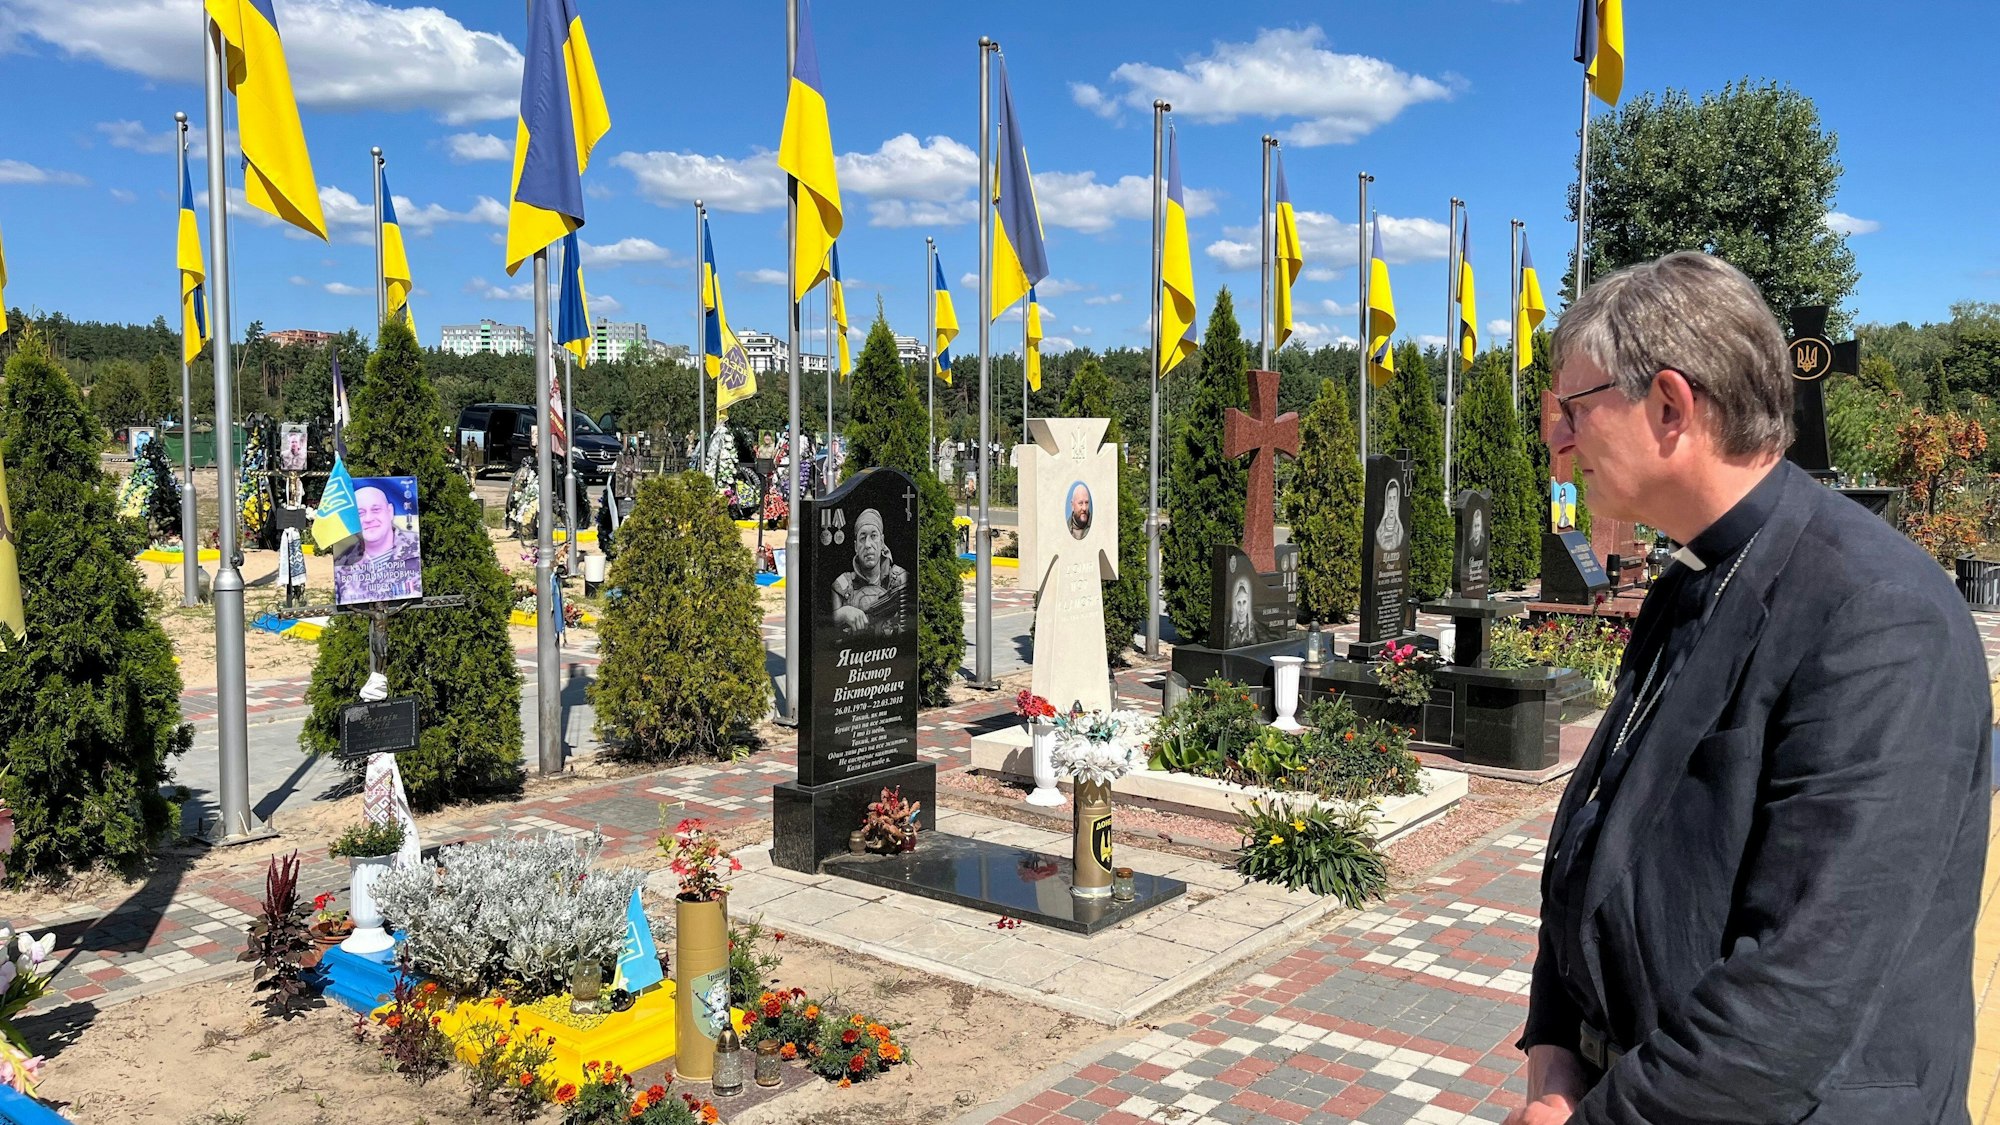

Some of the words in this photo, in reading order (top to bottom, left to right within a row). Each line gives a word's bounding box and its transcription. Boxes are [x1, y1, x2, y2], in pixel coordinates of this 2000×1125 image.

[341, 570, 415, 583] ВОЛОДИМИРОВИЧ
[836, 646, 897, 667] Ященко
[847, 667, 891, 683] Віктор
[833, 680, 904, 702] Вікторович
